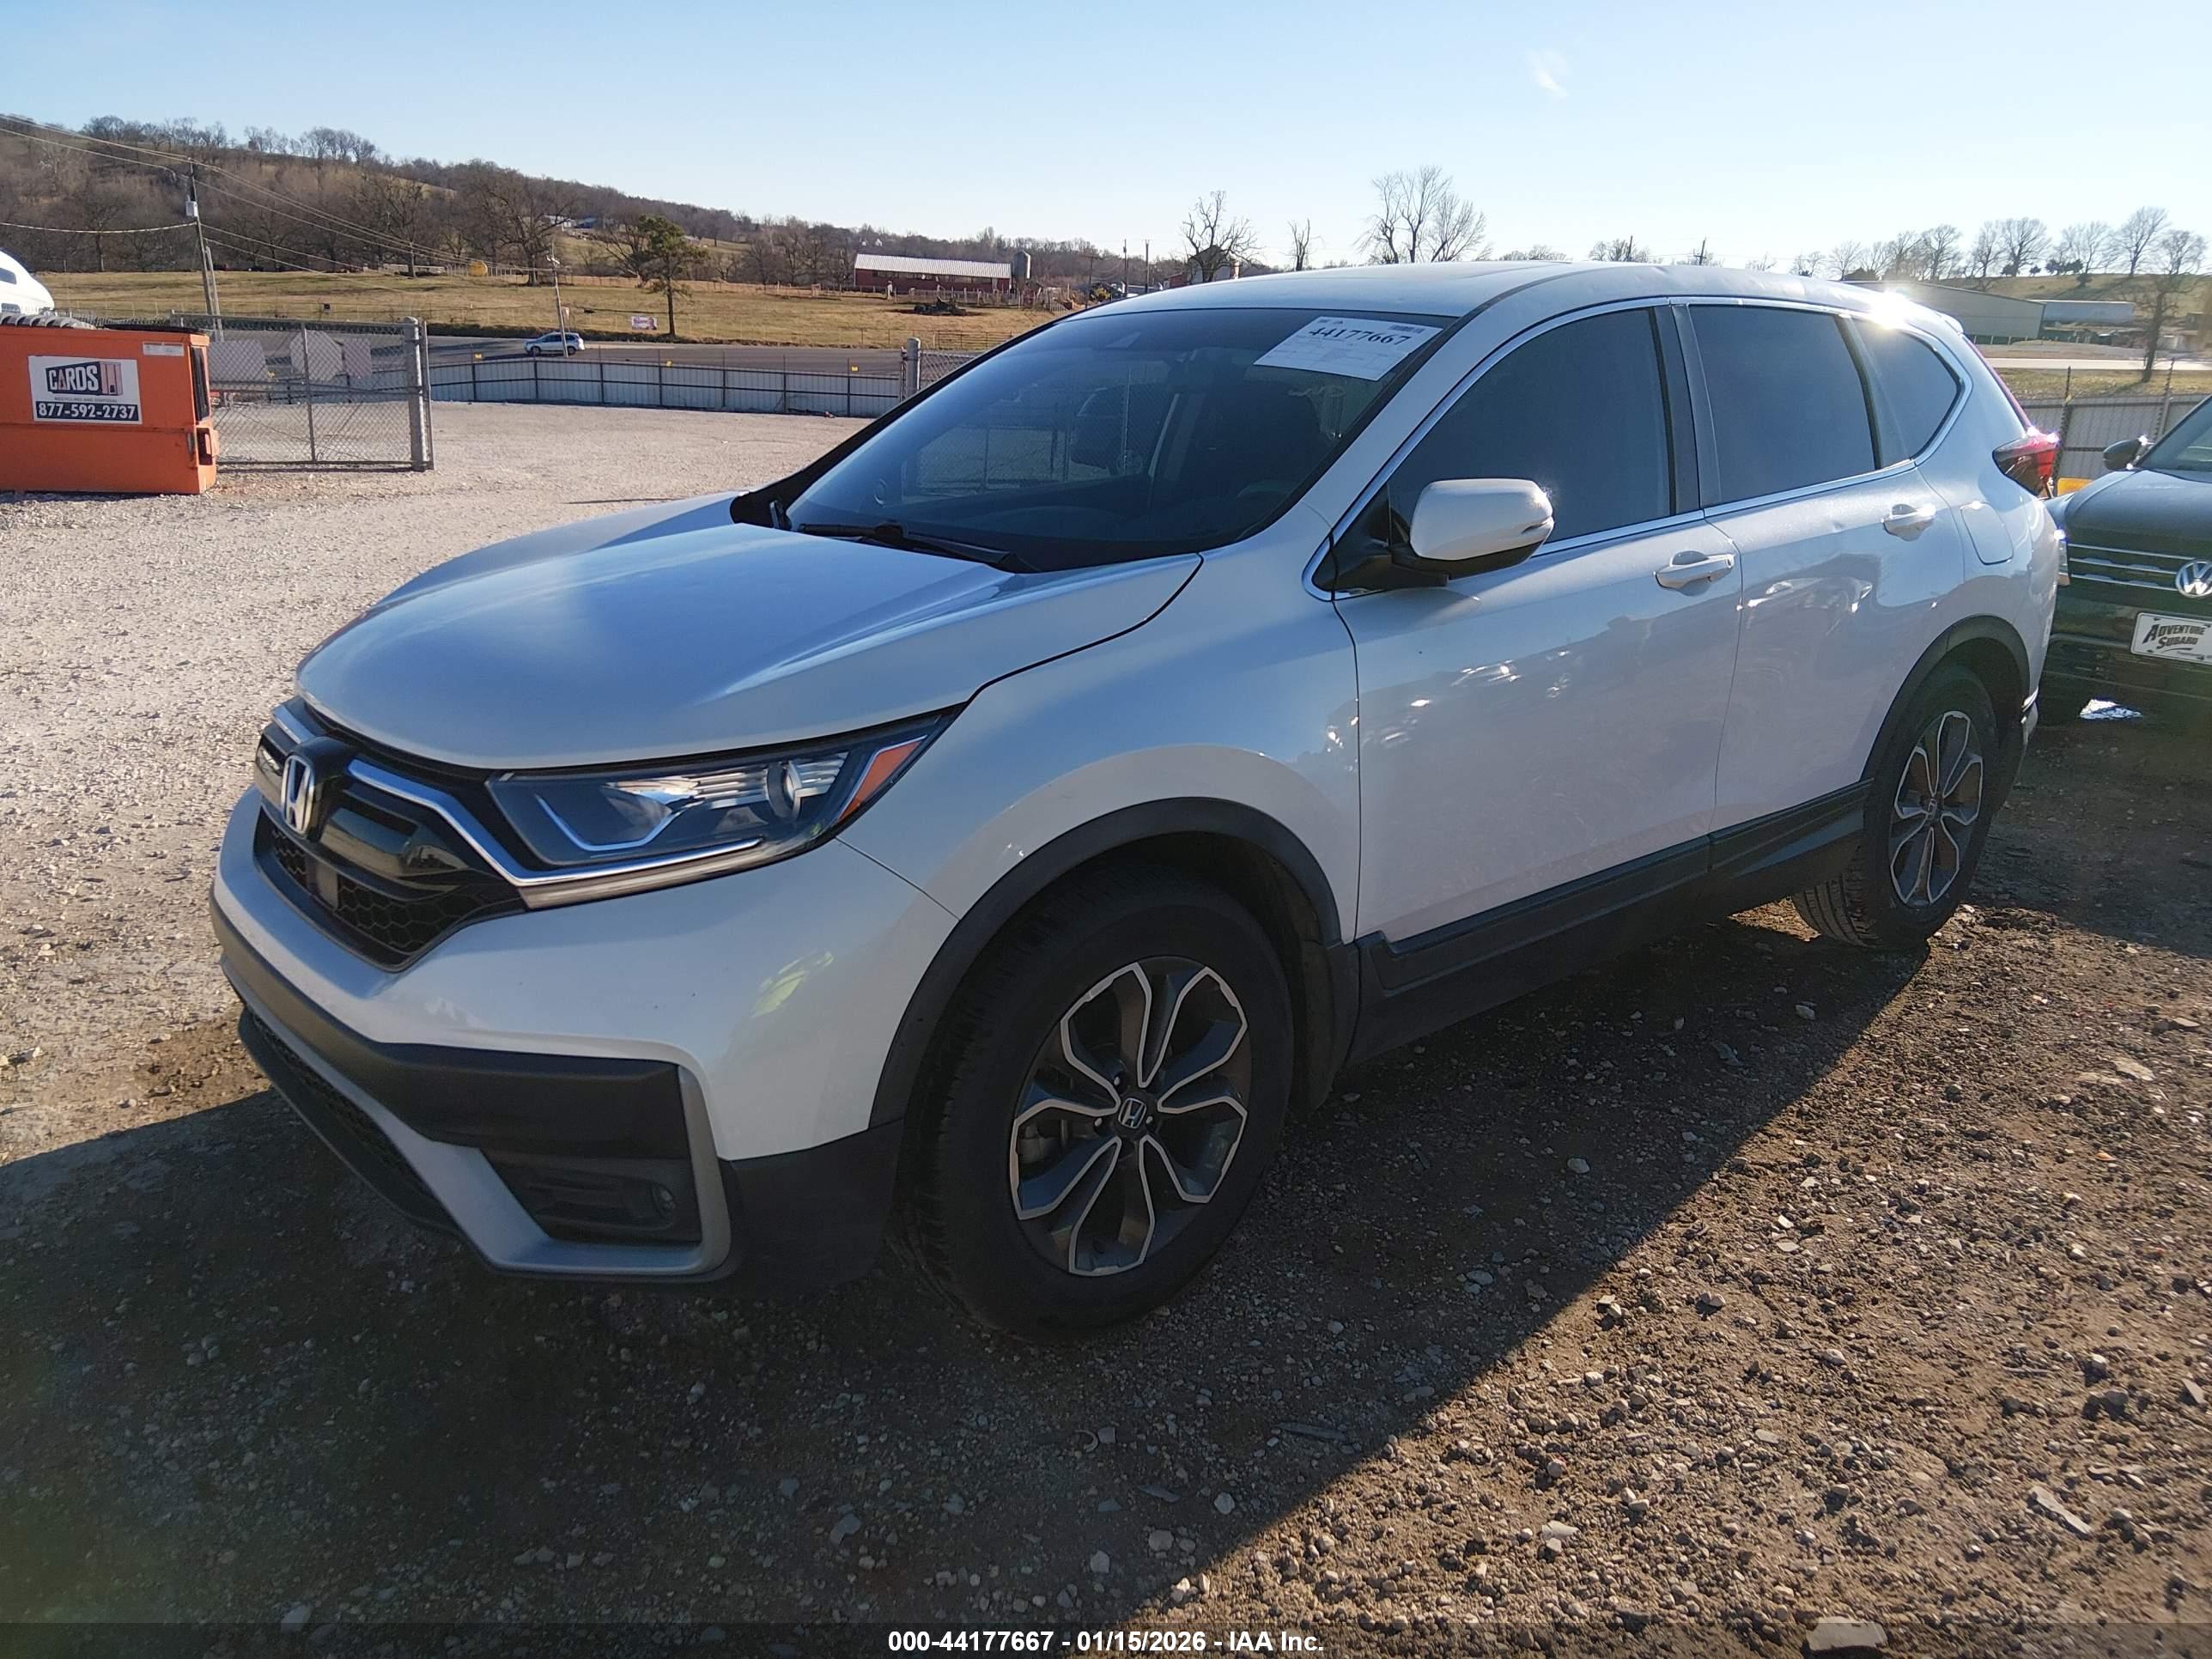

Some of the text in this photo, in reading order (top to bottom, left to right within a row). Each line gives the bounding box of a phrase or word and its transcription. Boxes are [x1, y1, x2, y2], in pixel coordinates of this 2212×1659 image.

[1310, 326, 1412, 345] 44177667
[48, 365, 99, 392] CARDS
[39, 403, 136, 419] 877-592-2737
[2142, 624, 2205, 644] ADVENTURE
[2157, 636, 2198, 649] SUBARU
